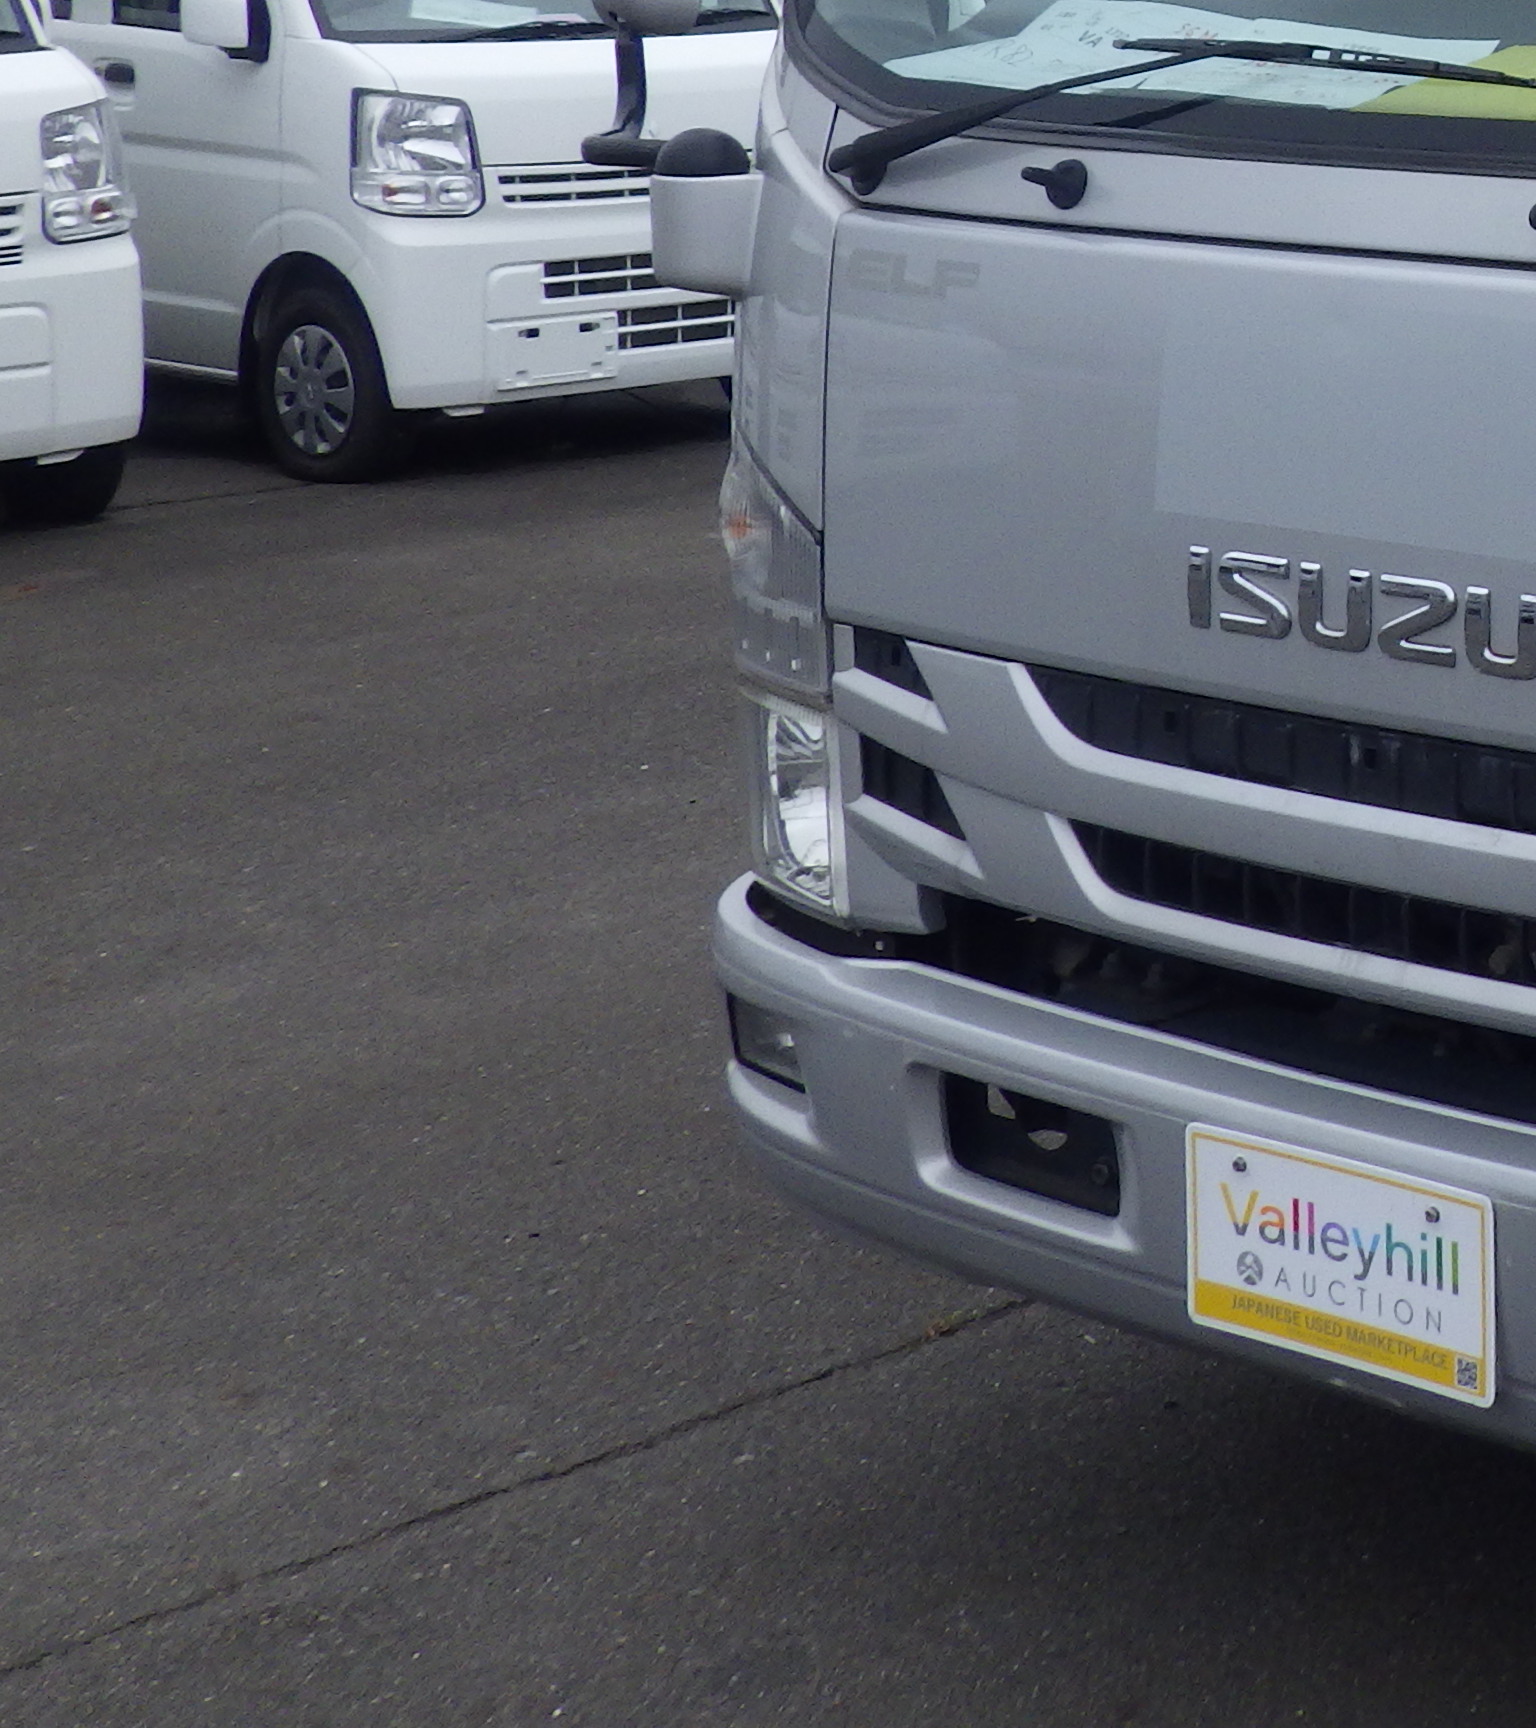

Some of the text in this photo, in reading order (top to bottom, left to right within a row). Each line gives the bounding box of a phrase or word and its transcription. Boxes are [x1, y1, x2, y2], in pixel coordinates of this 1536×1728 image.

[1219, 1181, 1459, 1295] Valleyhill
[1231, 1294, 1300, 1326] JAPANESE
[1304, 1315, 1343, 1338] USED
[1345, 1325, 1449, 1370] MARKETPLACE
[1275, 1267, 1442, 1333] AUCTION
